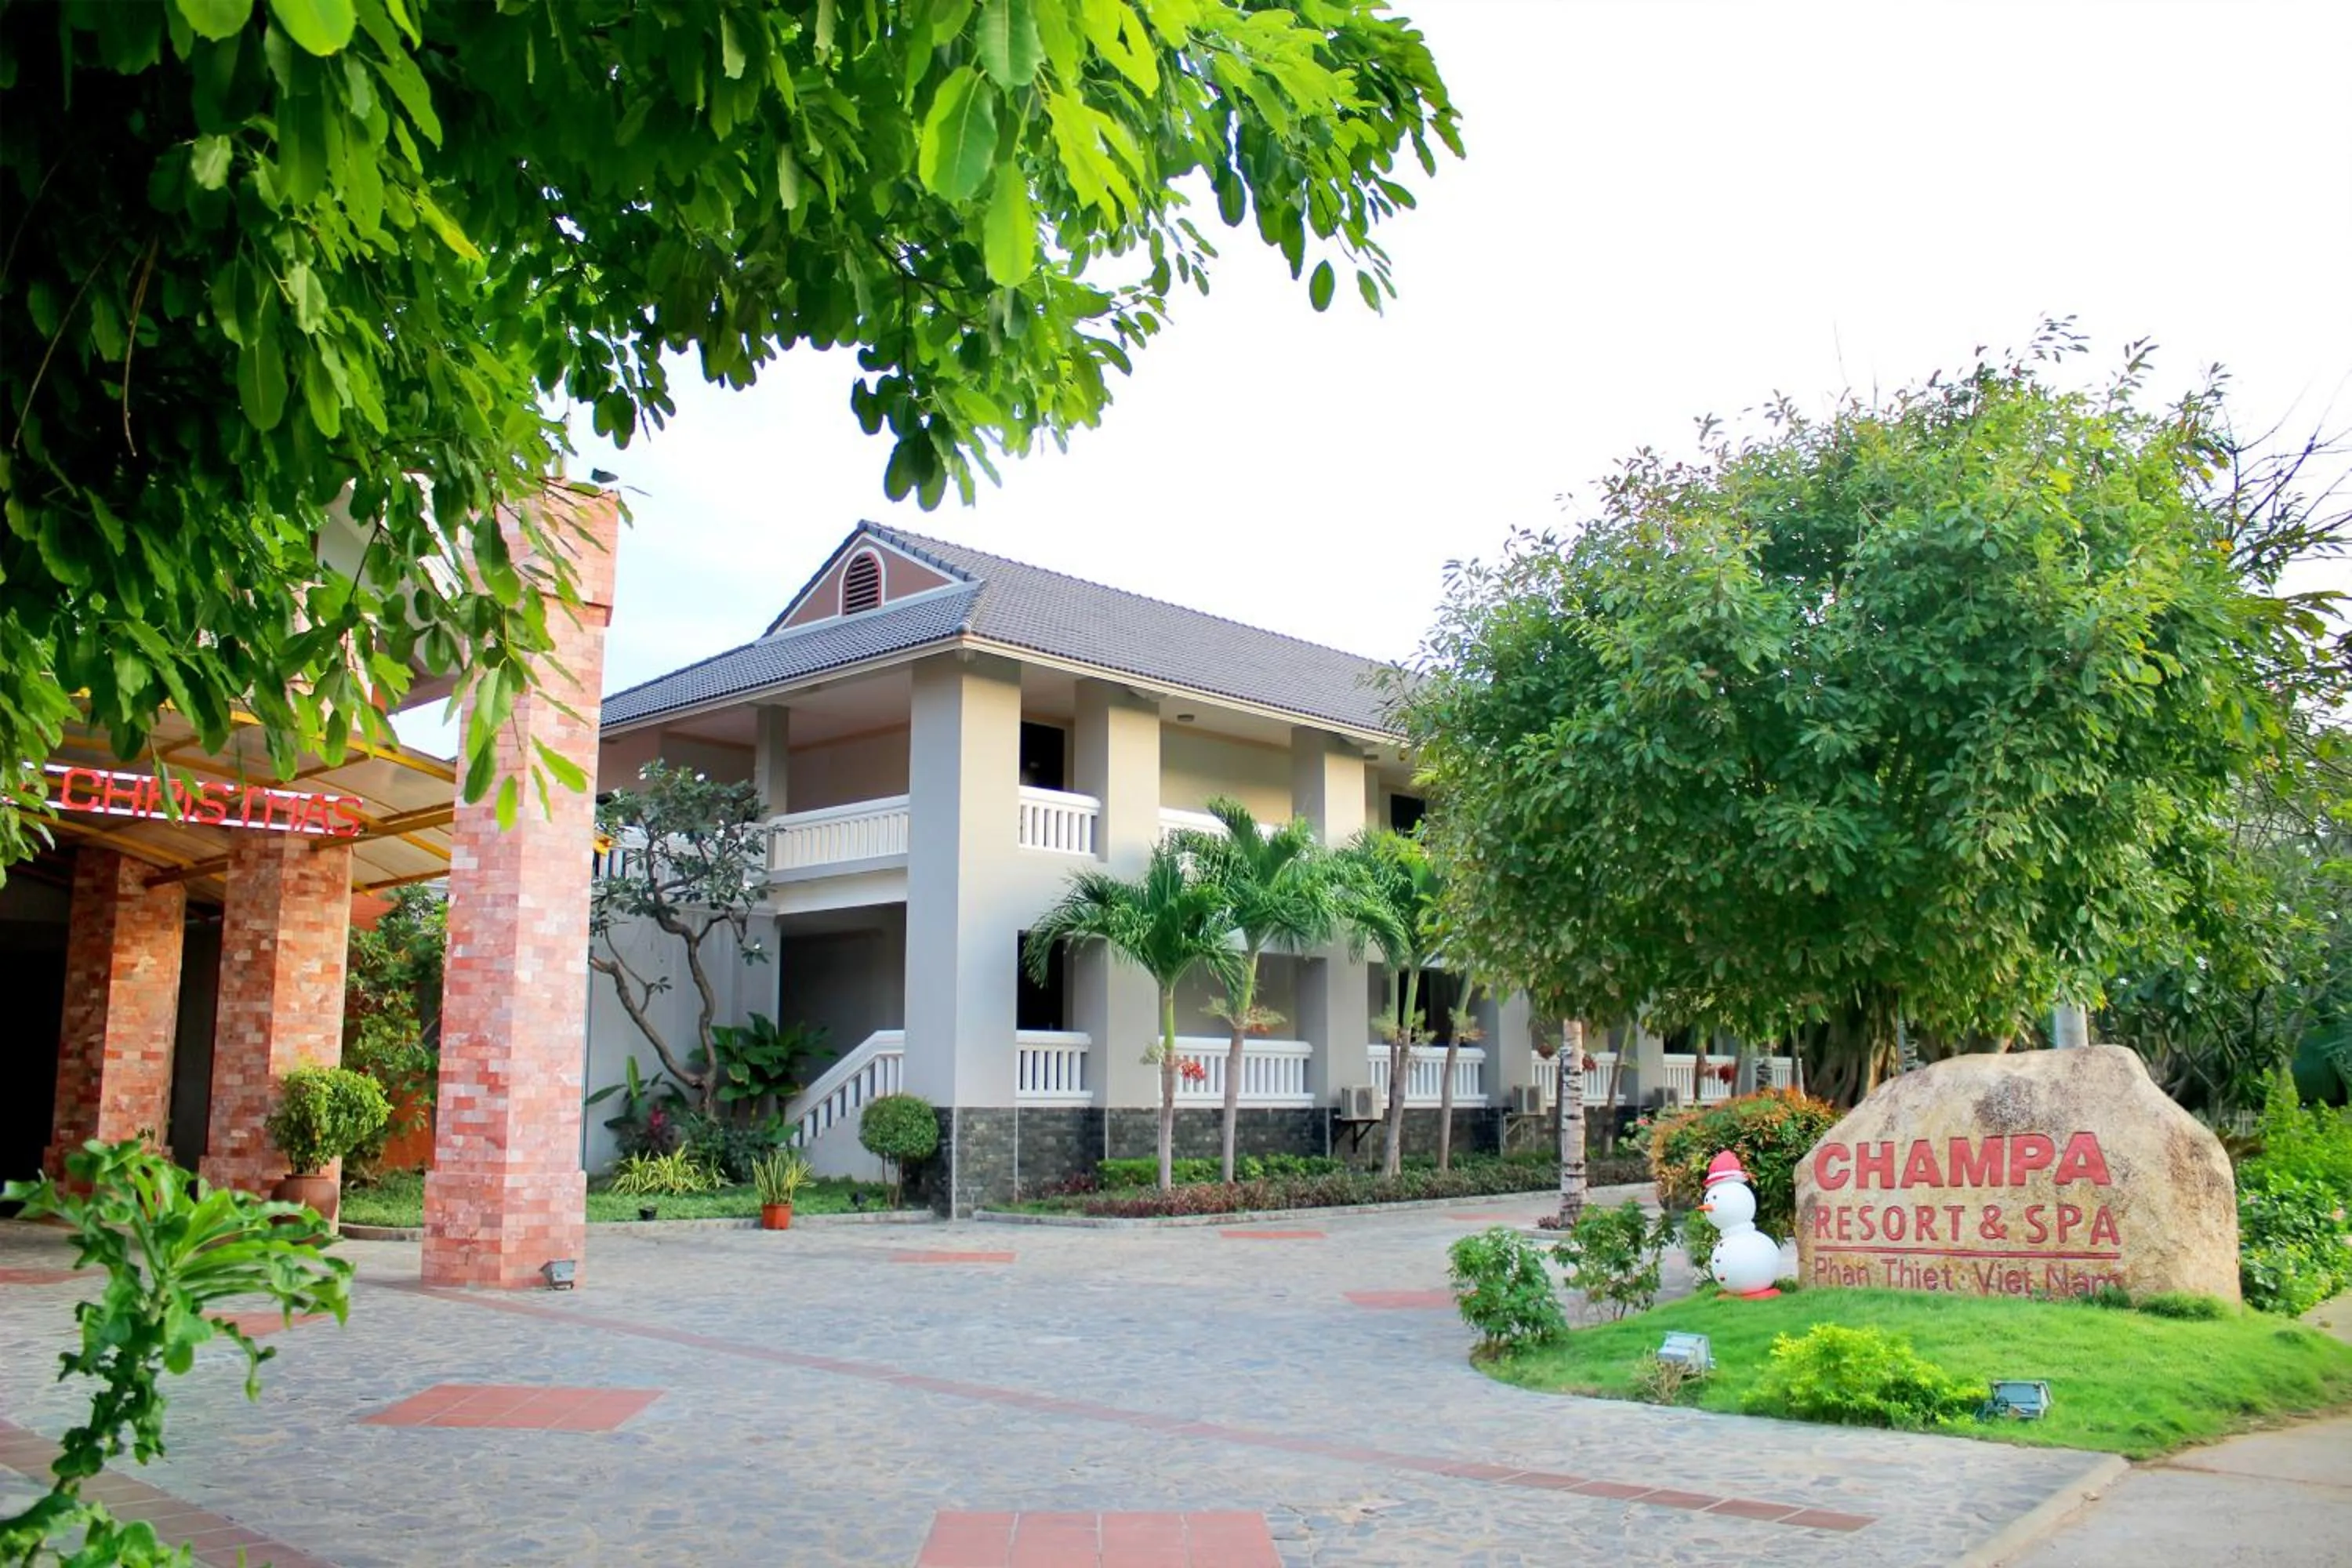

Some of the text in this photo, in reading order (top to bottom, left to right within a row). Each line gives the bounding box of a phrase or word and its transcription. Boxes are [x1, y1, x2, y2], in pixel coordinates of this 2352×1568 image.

[62, 767, 364, 837] CHRISTMAS
[1813, 1131, 2112, 1191] CHAMPA
[1813, 1203, 2122, 1246] RESORT & SPA
[1813, 1256, 2125, 1301] Phan Thiet Viet Nam
